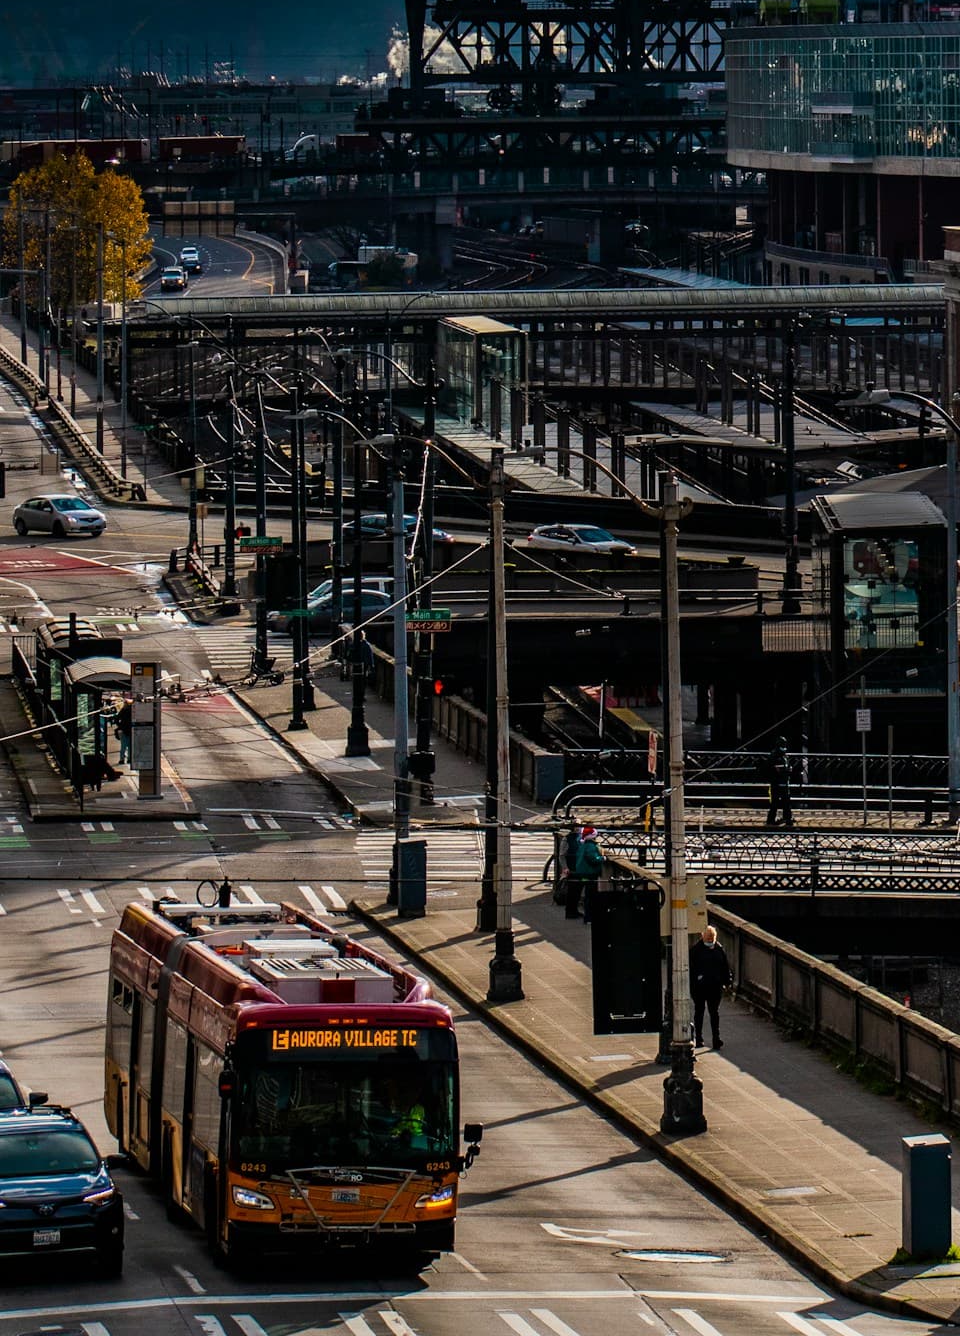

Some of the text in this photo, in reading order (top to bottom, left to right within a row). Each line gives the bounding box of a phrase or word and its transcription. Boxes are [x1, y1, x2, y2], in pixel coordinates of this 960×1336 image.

[412, 611, 431, 619] Main
[291, 1031, 341, 1047] AURORA
[345, 1030, 397, 1047] VILLAGE
[402, 1030, 417, 1047] TC
[241, 1163, 267, 1172] 6243
[426, 1161, 451, 1171] 6243
